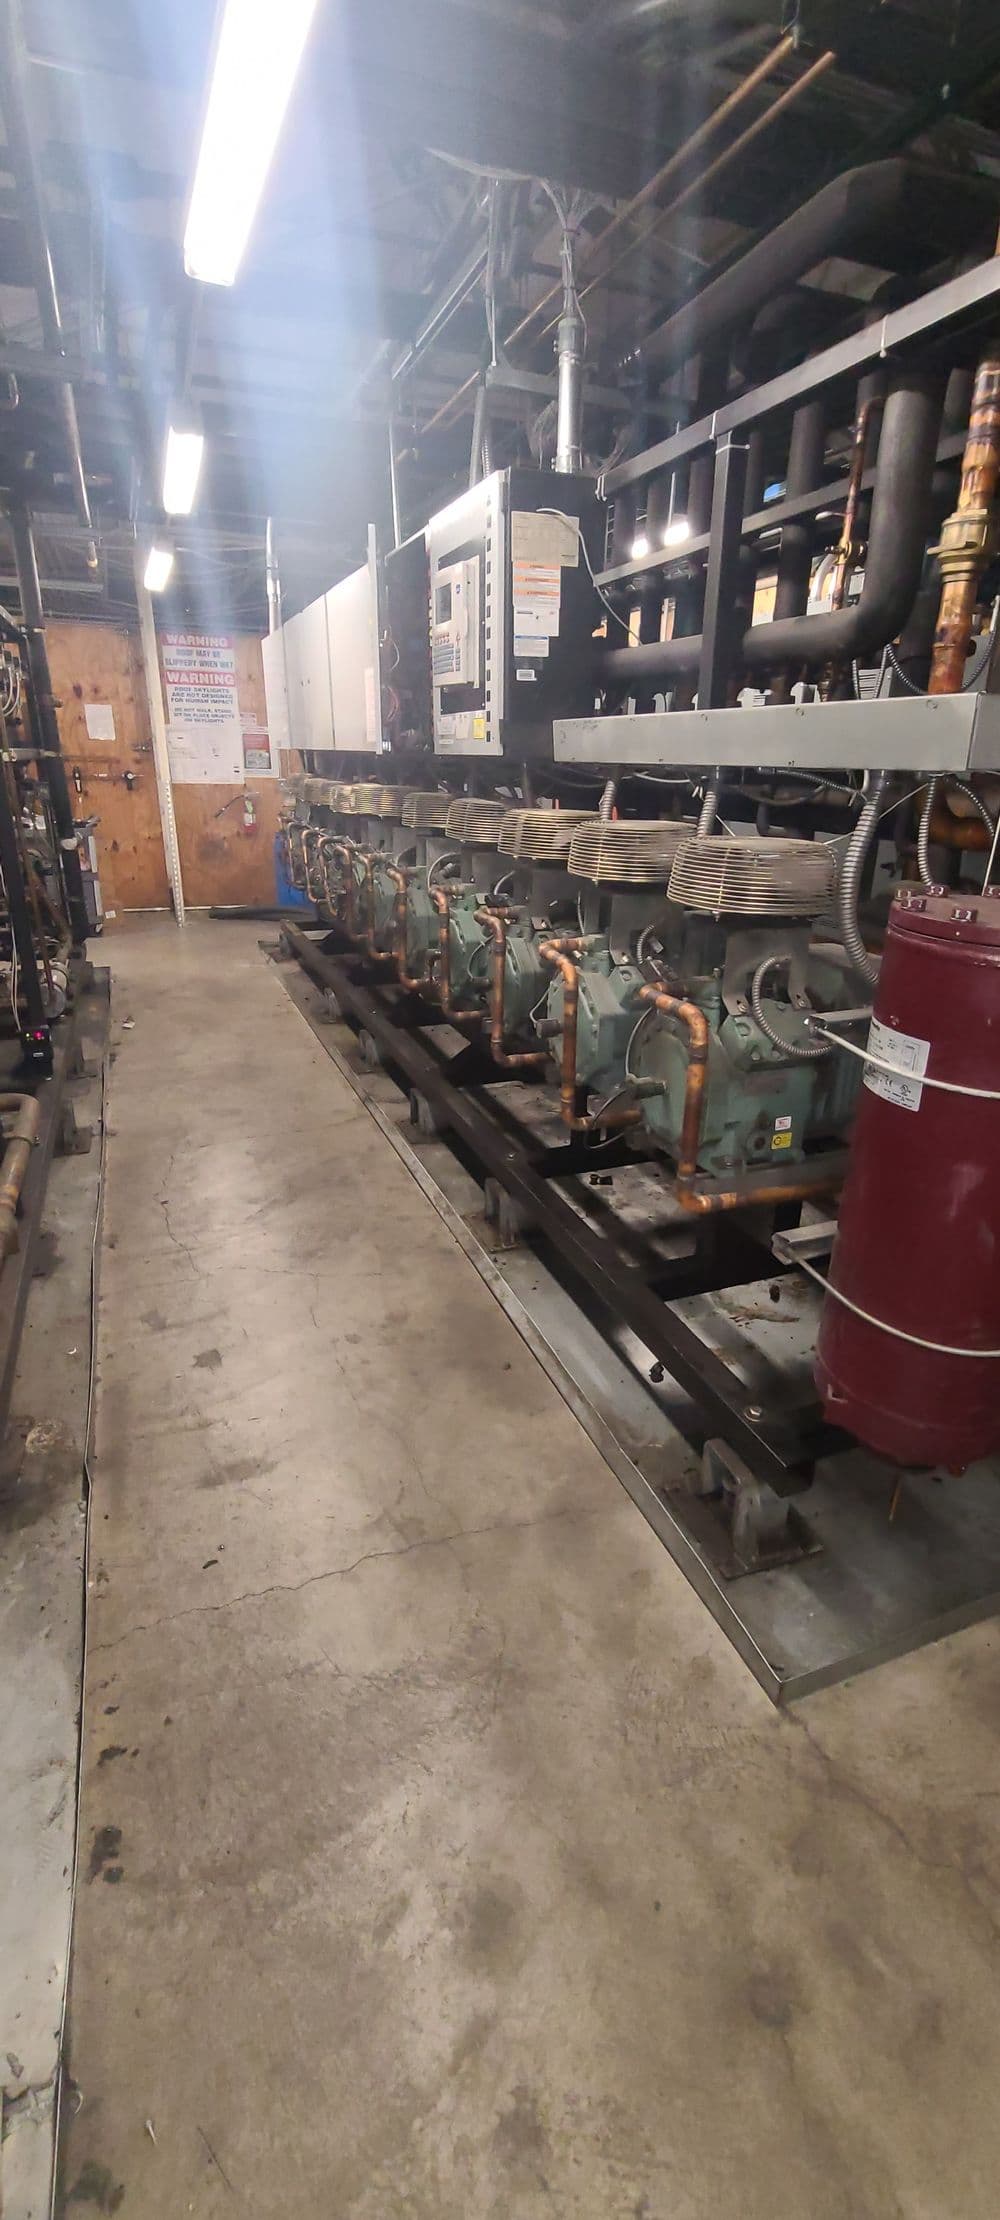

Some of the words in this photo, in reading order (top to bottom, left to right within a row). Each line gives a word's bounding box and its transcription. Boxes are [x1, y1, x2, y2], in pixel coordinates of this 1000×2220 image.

[166, 634, 228, 647] WARNING
[196, 649, 209, 657] MAY
[199, 660, 218, 668] WHEN
[167, 671, 235, 685] WARNING
